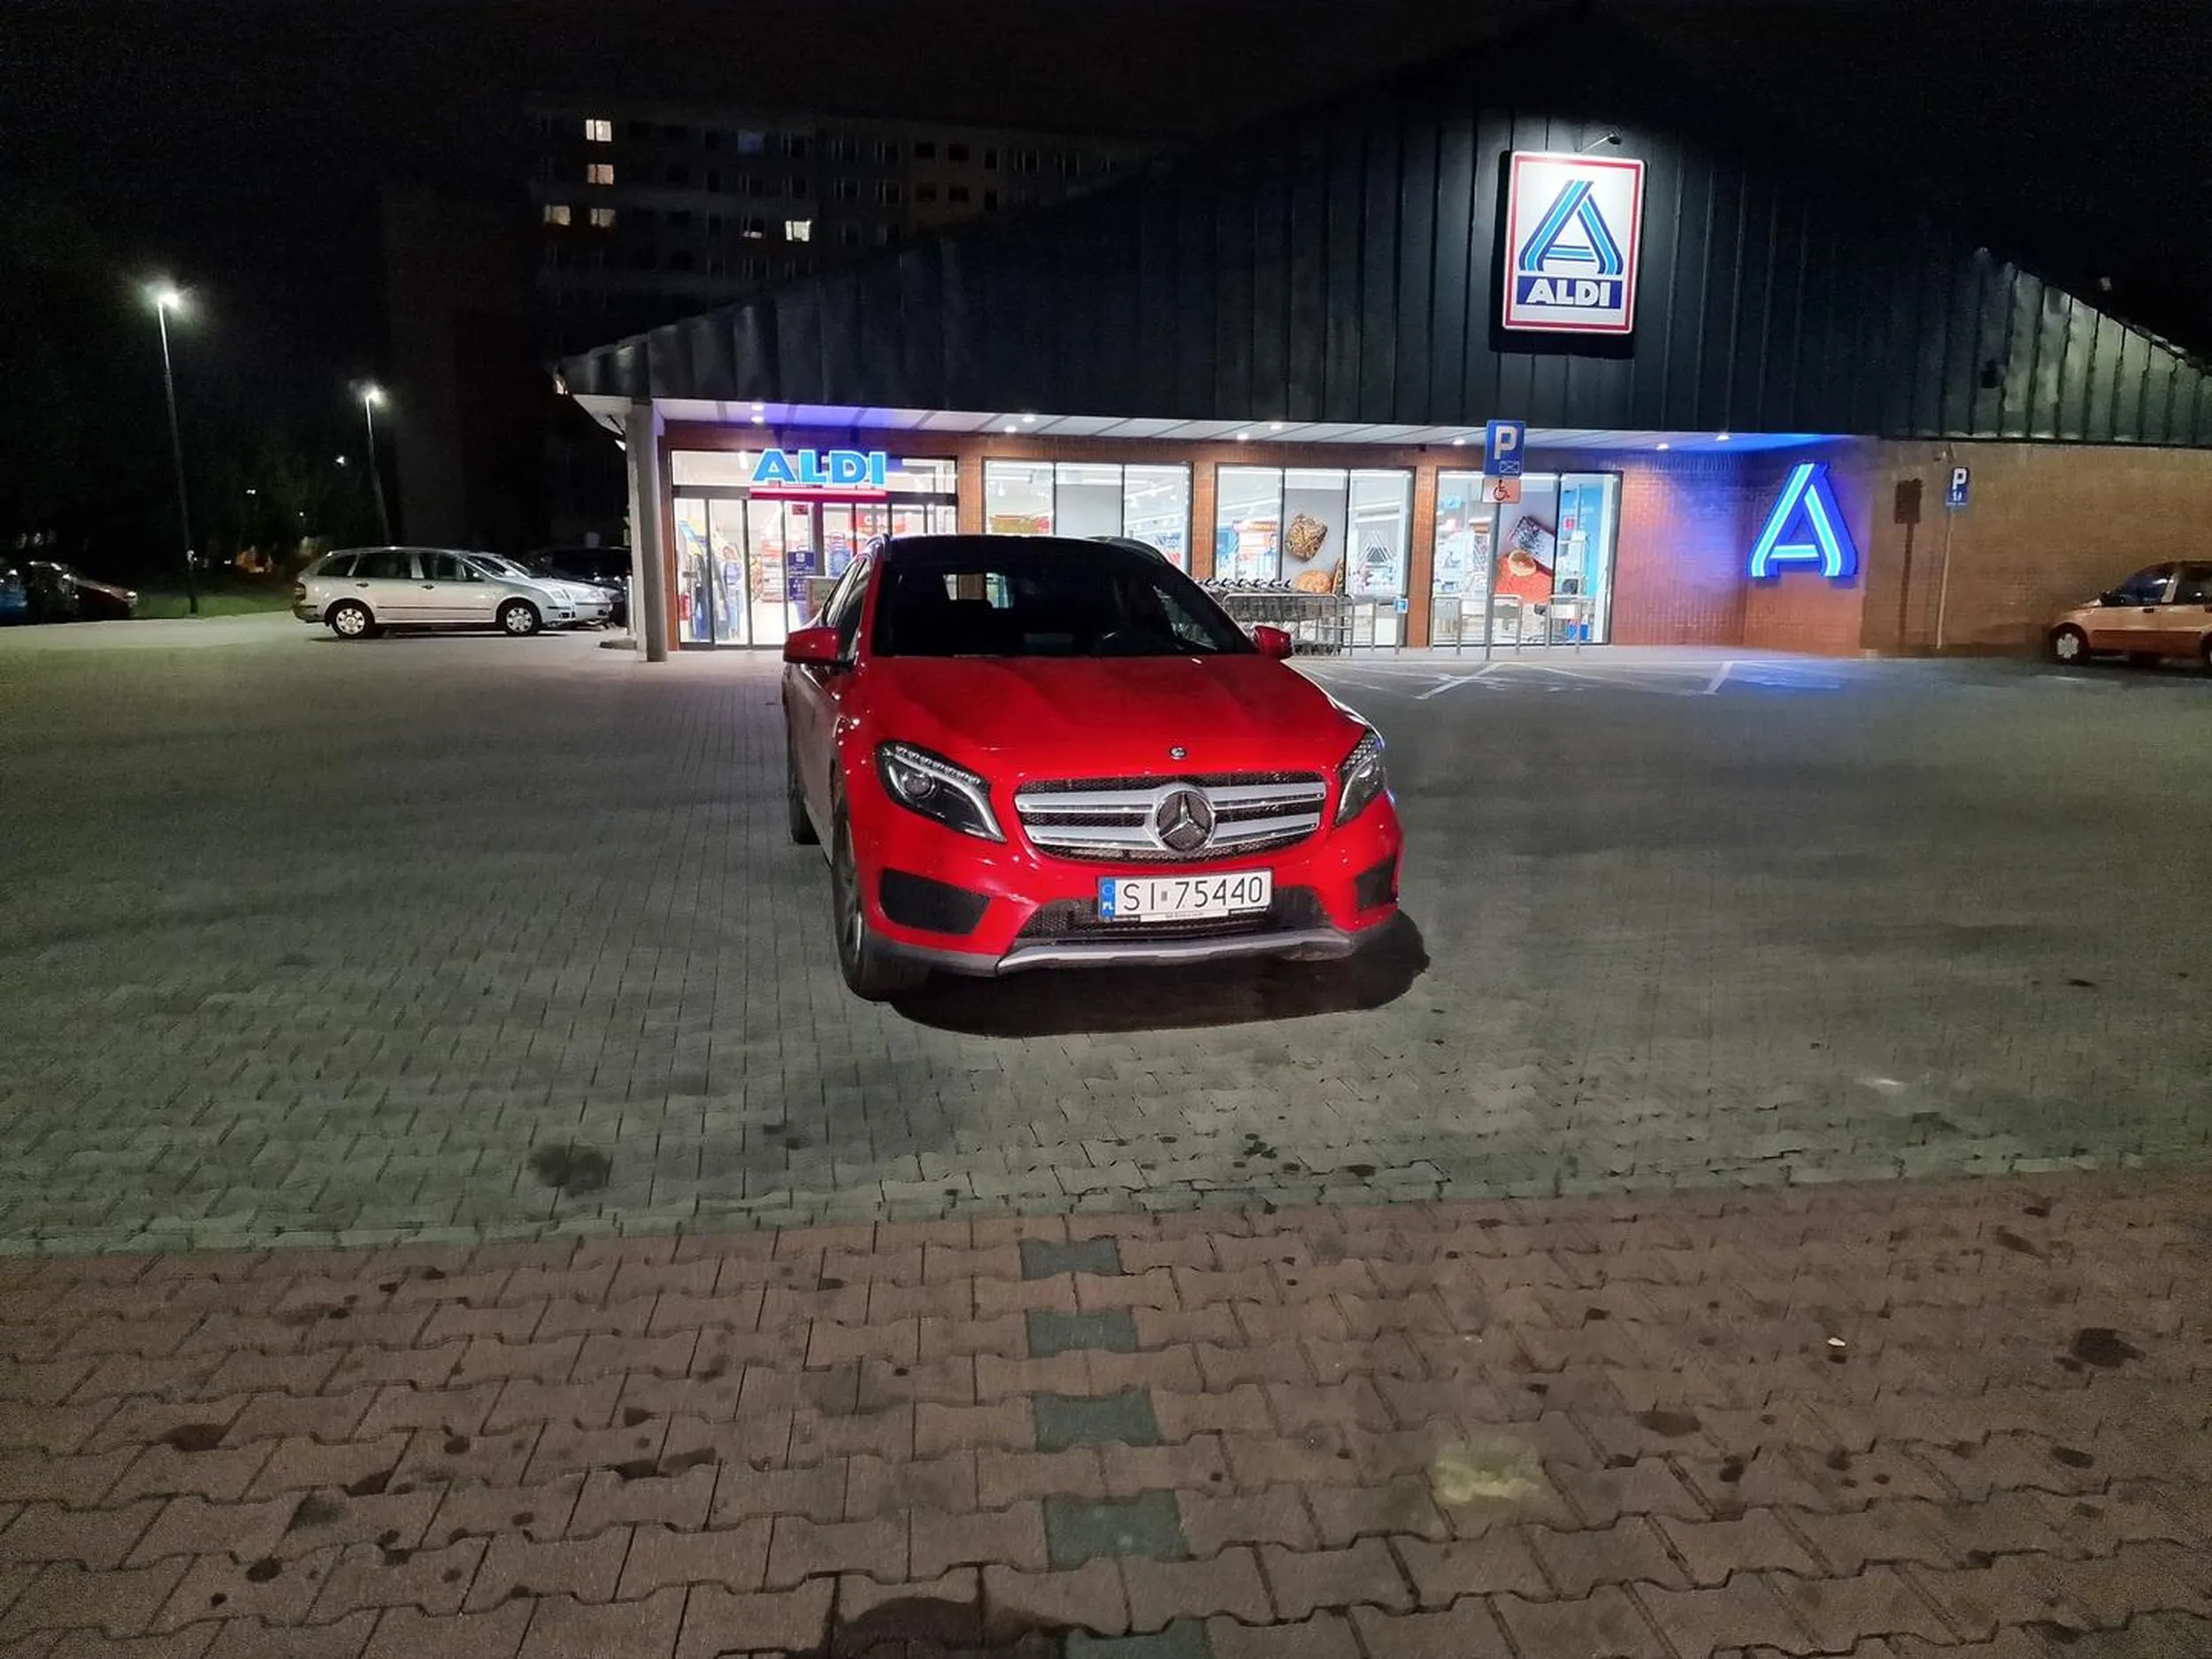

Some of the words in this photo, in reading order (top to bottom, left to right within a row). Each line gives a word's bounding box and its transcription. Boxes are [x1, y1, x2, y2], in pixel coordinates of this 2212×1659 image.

[1526, 279, 1611, 306] ALDI
[1494, 426, 1517, 459] P
[751, 449, 887, 485] ALDI
[1952, 468, 1967, 489] P
[1123, 882, 1155, 911] SI
[1175, 876, 1263, 910] 75440
